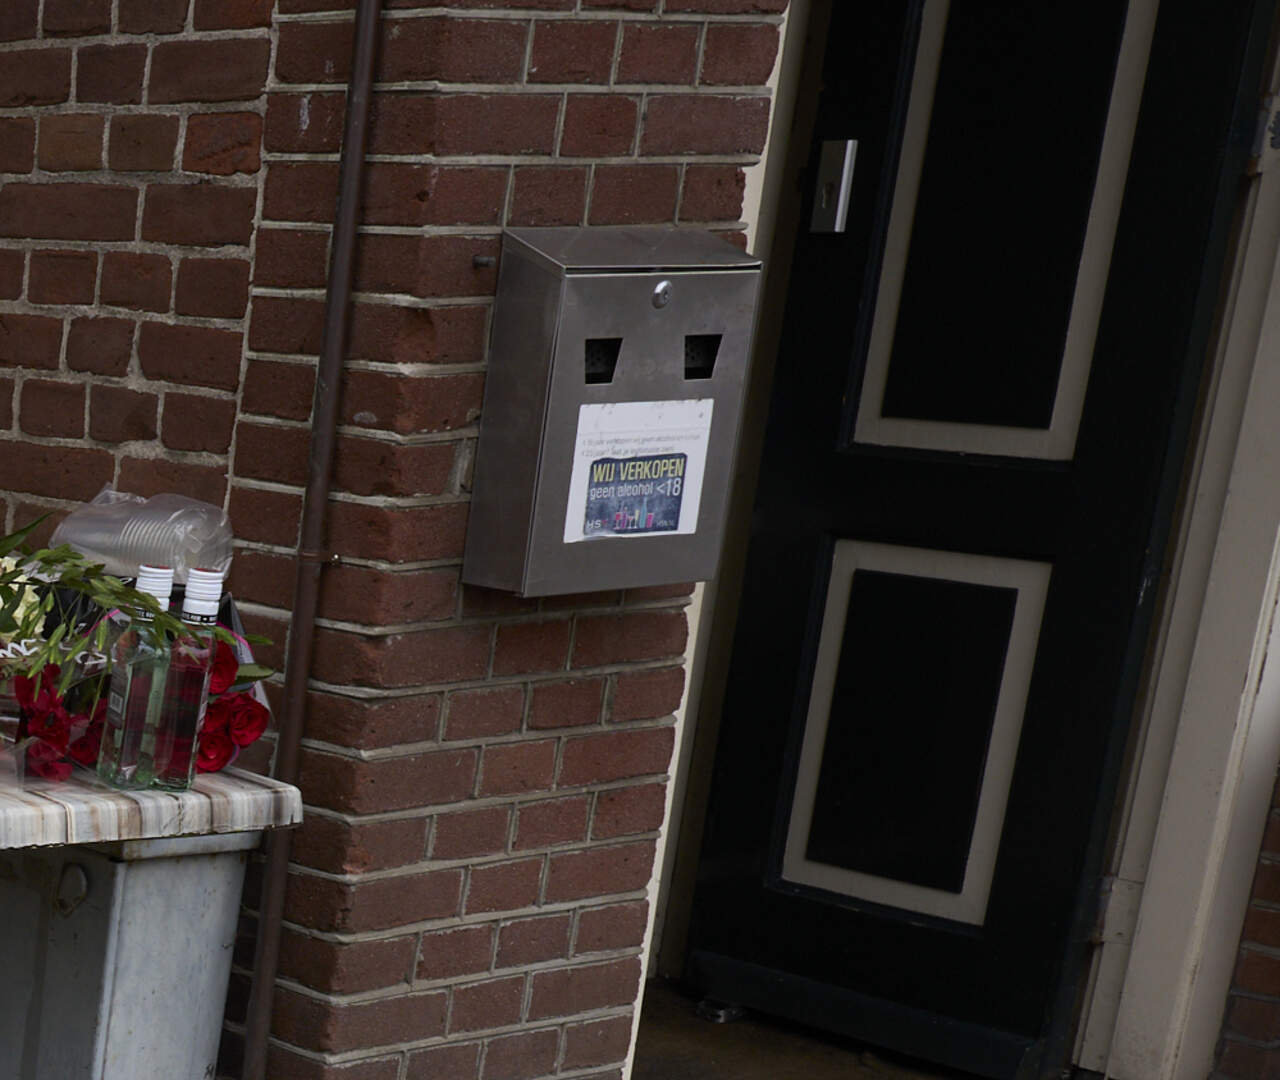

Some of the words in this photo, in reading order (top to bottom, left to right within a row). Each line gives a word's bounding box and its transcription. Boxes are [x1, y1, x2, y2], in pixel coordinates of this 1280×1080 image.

[593, 463, 616, 482] WIJ
[619, 458, 685, 481] VERKOPEN
[589, 486, 615, 501] geen
[617, 482, 654, 497] alcohol
